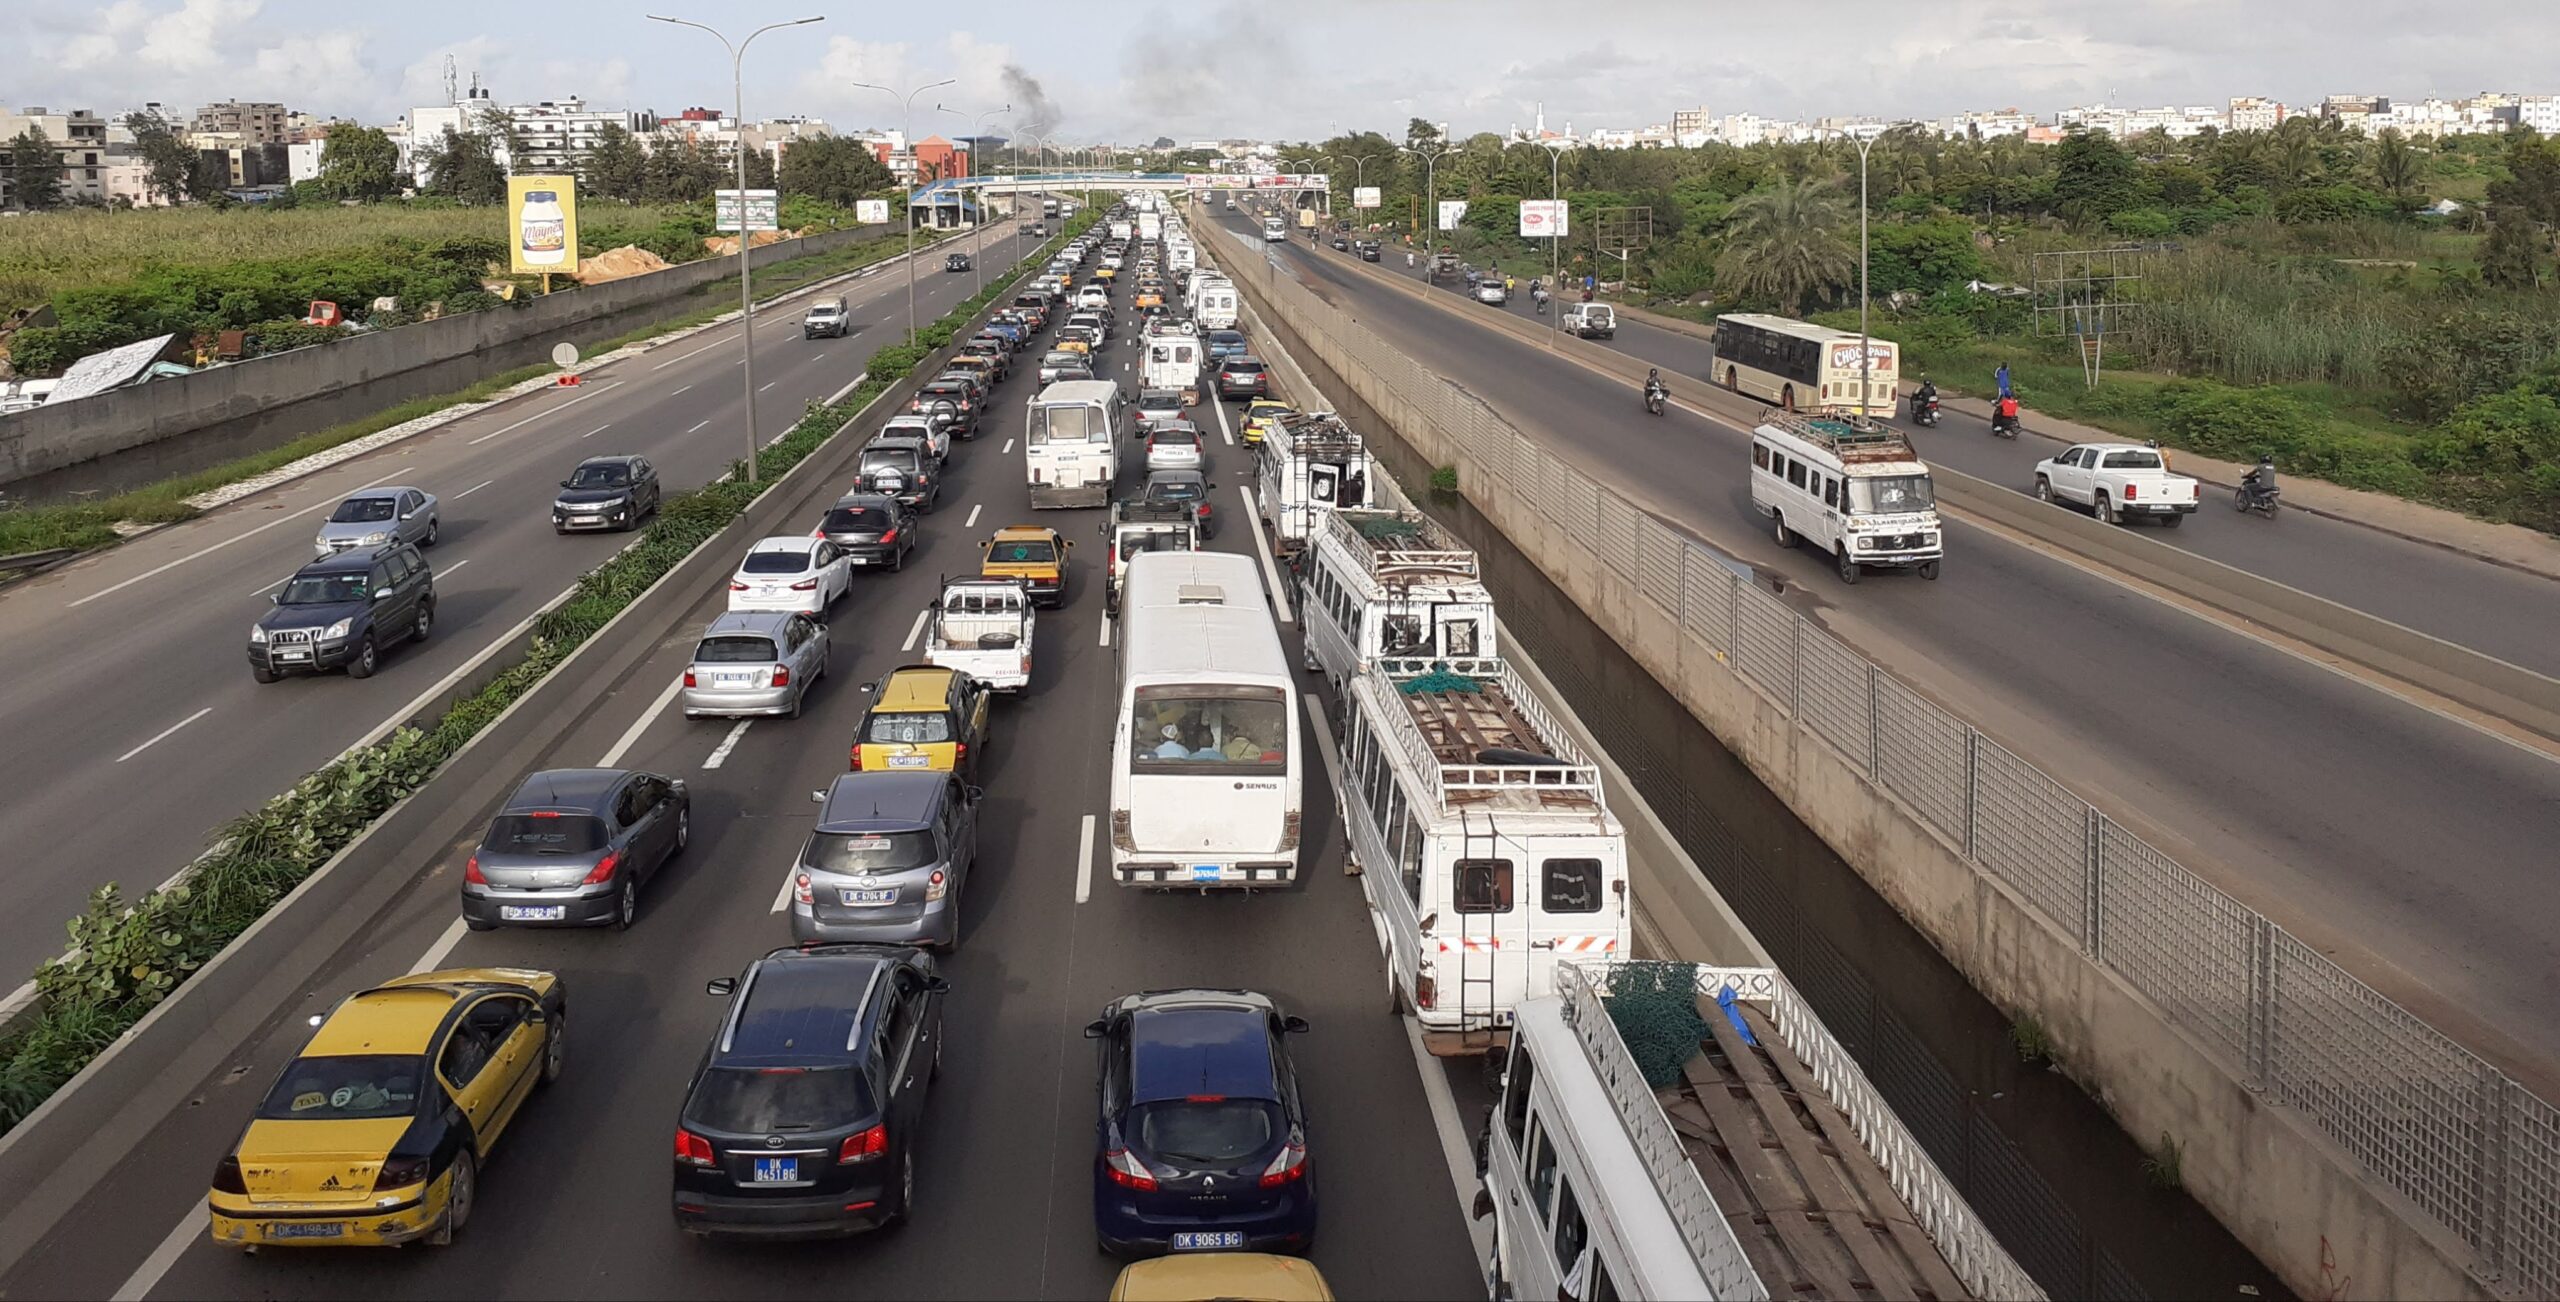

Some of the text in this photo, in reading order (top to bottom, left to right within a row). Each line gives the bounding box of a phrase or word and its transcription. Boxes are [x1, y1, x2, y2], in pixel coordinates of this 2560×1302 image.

[300, 1094, 321, 1107] TAXI
[769, 1158, 782, 1169] DK
[757, 1168, 796, 1181] 8451 BG
[1178, 1232, 1239, 1247] DK 9065 BG
